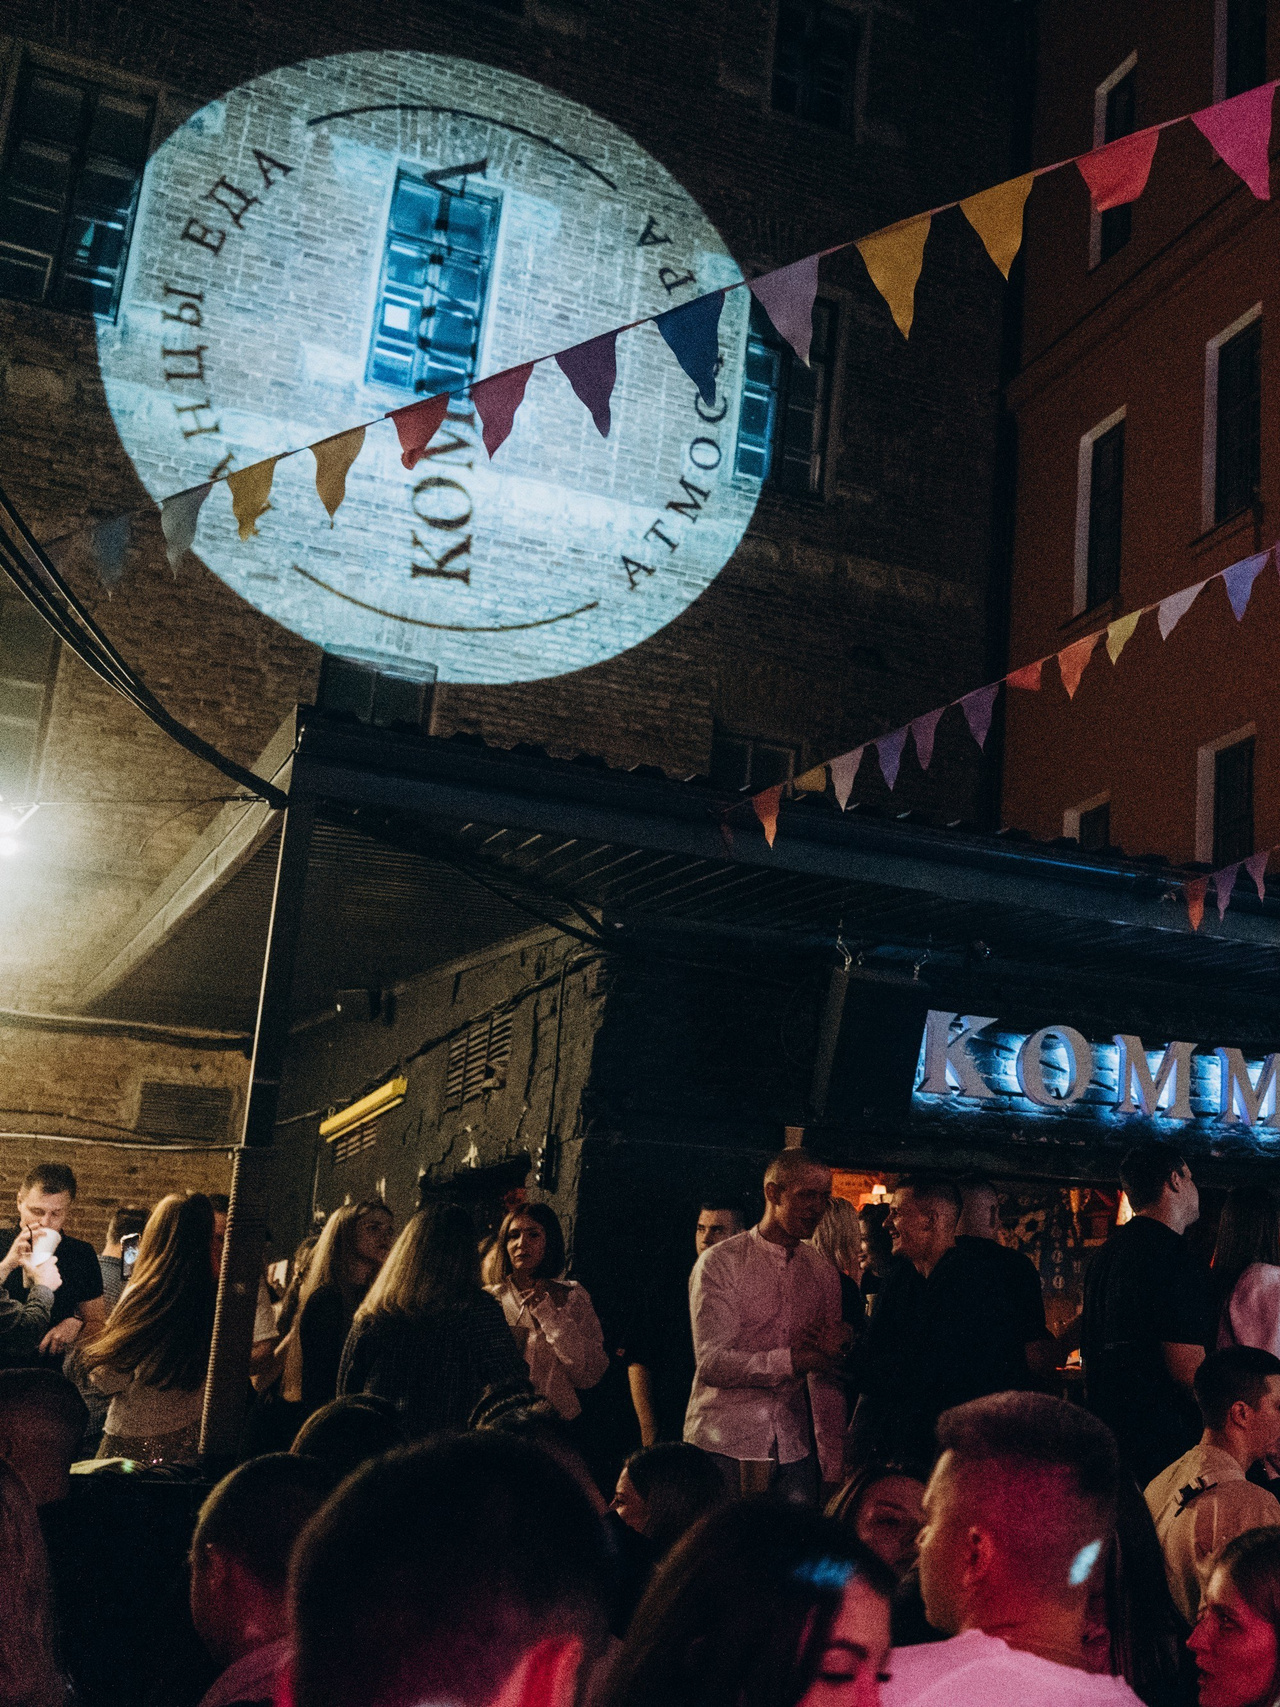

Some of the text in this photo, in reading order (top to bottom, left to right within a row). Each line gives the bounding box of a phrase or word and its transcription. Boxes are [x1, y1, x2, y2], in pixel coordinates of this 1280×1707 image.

[180, 149, 293, 255] ЕДА
[411, 158, 488, 585] КОМА
[621, 215, 729, 590] АТМОСРА
